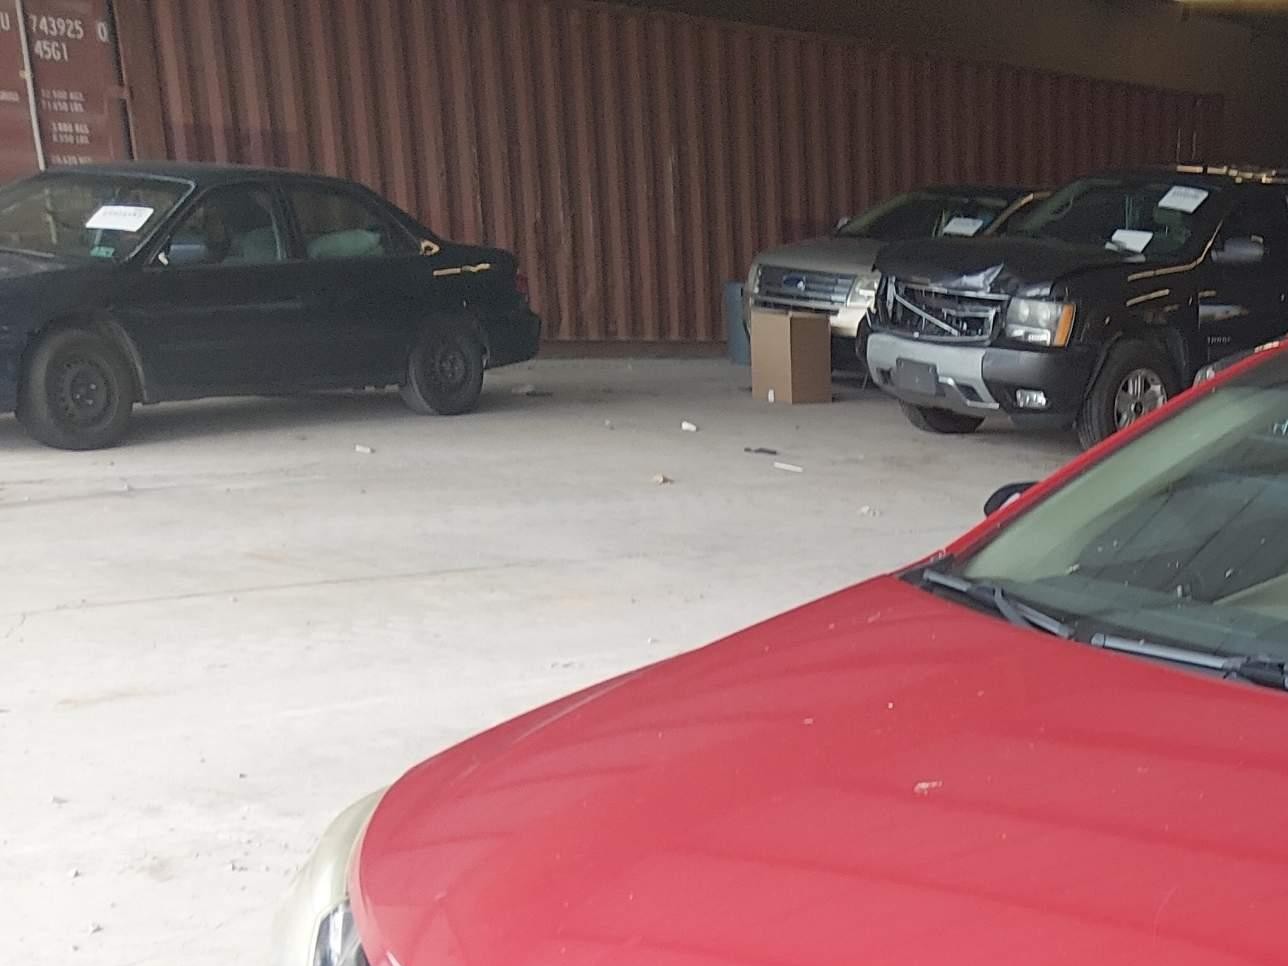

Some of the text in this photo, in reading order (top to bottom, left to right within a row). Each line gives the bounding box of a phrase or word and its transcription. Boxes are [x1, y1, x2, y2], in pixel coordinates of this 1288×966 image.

[29, 15, 84, 39] 743925
[98, 22, 108, 42] 0
[34, 40, 69, 62] 45G1
